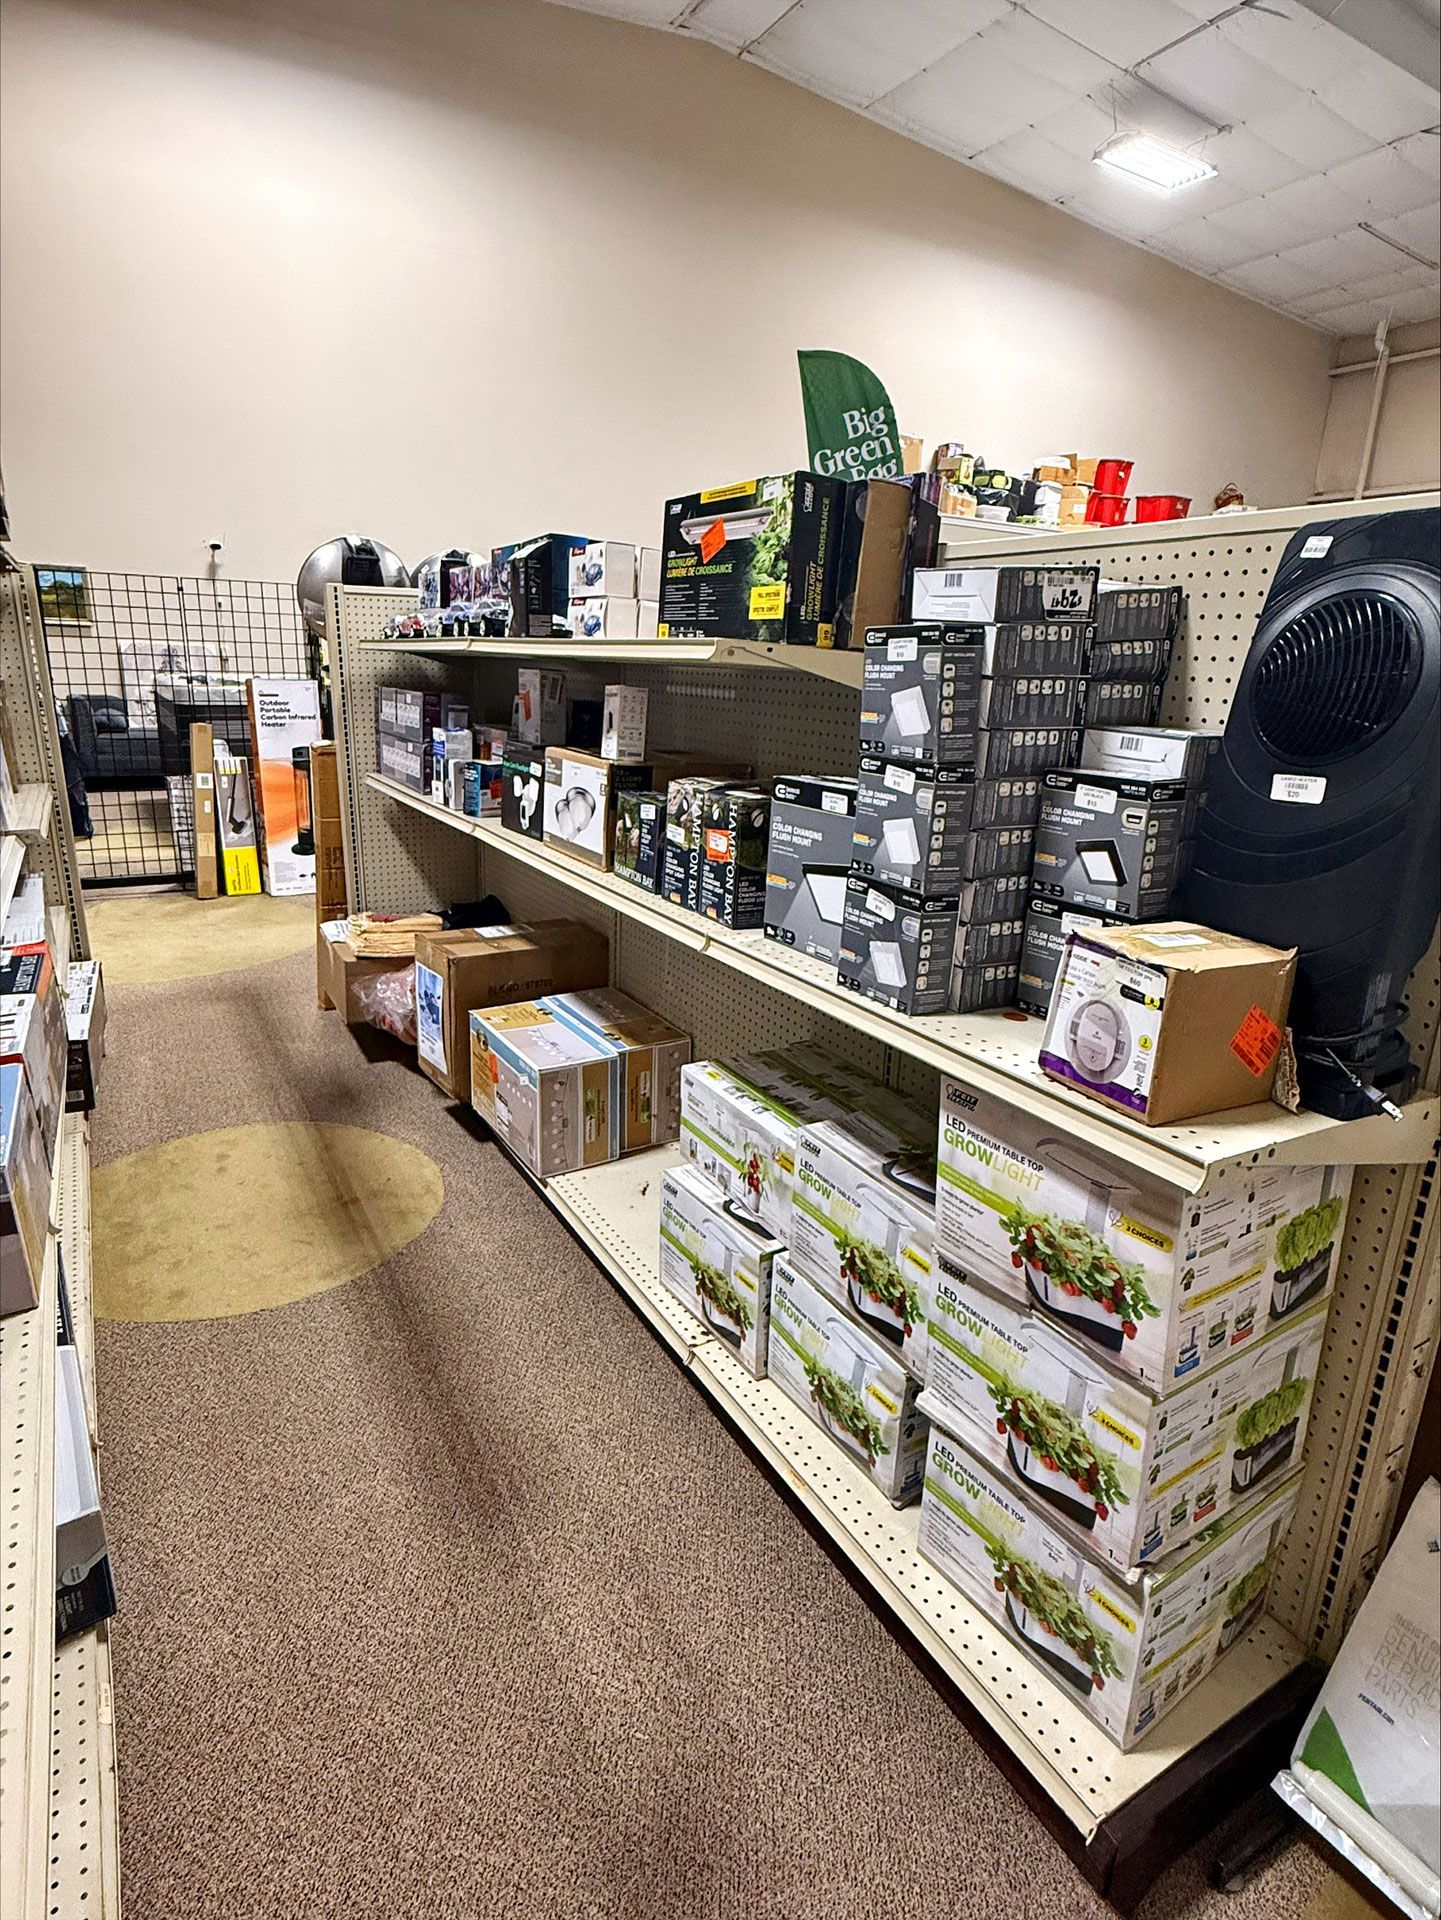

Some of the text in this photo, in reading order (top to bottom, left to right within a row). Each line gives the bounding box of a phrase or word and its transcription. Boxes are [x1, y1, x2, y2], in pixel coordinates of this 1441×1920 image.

[842, 406, 889, 440] Big
[814, 436, 895, 476] Green
[817, 497, 830, 565] CROISSANCE
[1041, 814, 1083, 826] FLUSH MOUNT
[1042, 806, 1095, 821] COLOR CHANGING
[771, 831, 813, 847] FLUSH MOUNT
[772, 822, 823, 841] COLOR CHANGING
[688, 792, 704, 909] HAMPTON BAY
[724, 802, 738, 924] HAMPTON BAY
[614, 862, 654, 889] HAMPTON BAY
[1027, 936, 1047, 946] FLUSH
[1028, 929, 1049, 940] COLOR
[946, 1114, 1044, 1172] LED PREMIUM TABLE TOP
[800, 1158, 862, 1209] LED PREMIUM TABLE TOP
[663, 1198, 674, 1211] LED
[1131, 1228, 1164, 1248] CHOICES
[775, 1284, 788, 1300] LED
[938, 1282, 1029, 1353] LED PREMIUM TABLE TOP
[1105, 1421, 1134, 1445] CHOICES
[935, 1441, 1026, 1523] LED PREMIUM TABLE TOP
[1394, 1614, 1430, 1645] INSIST
[1384, 1625, 1440, 1679] GENUI
[1365, 1664, 1420, 1719] PARTS
